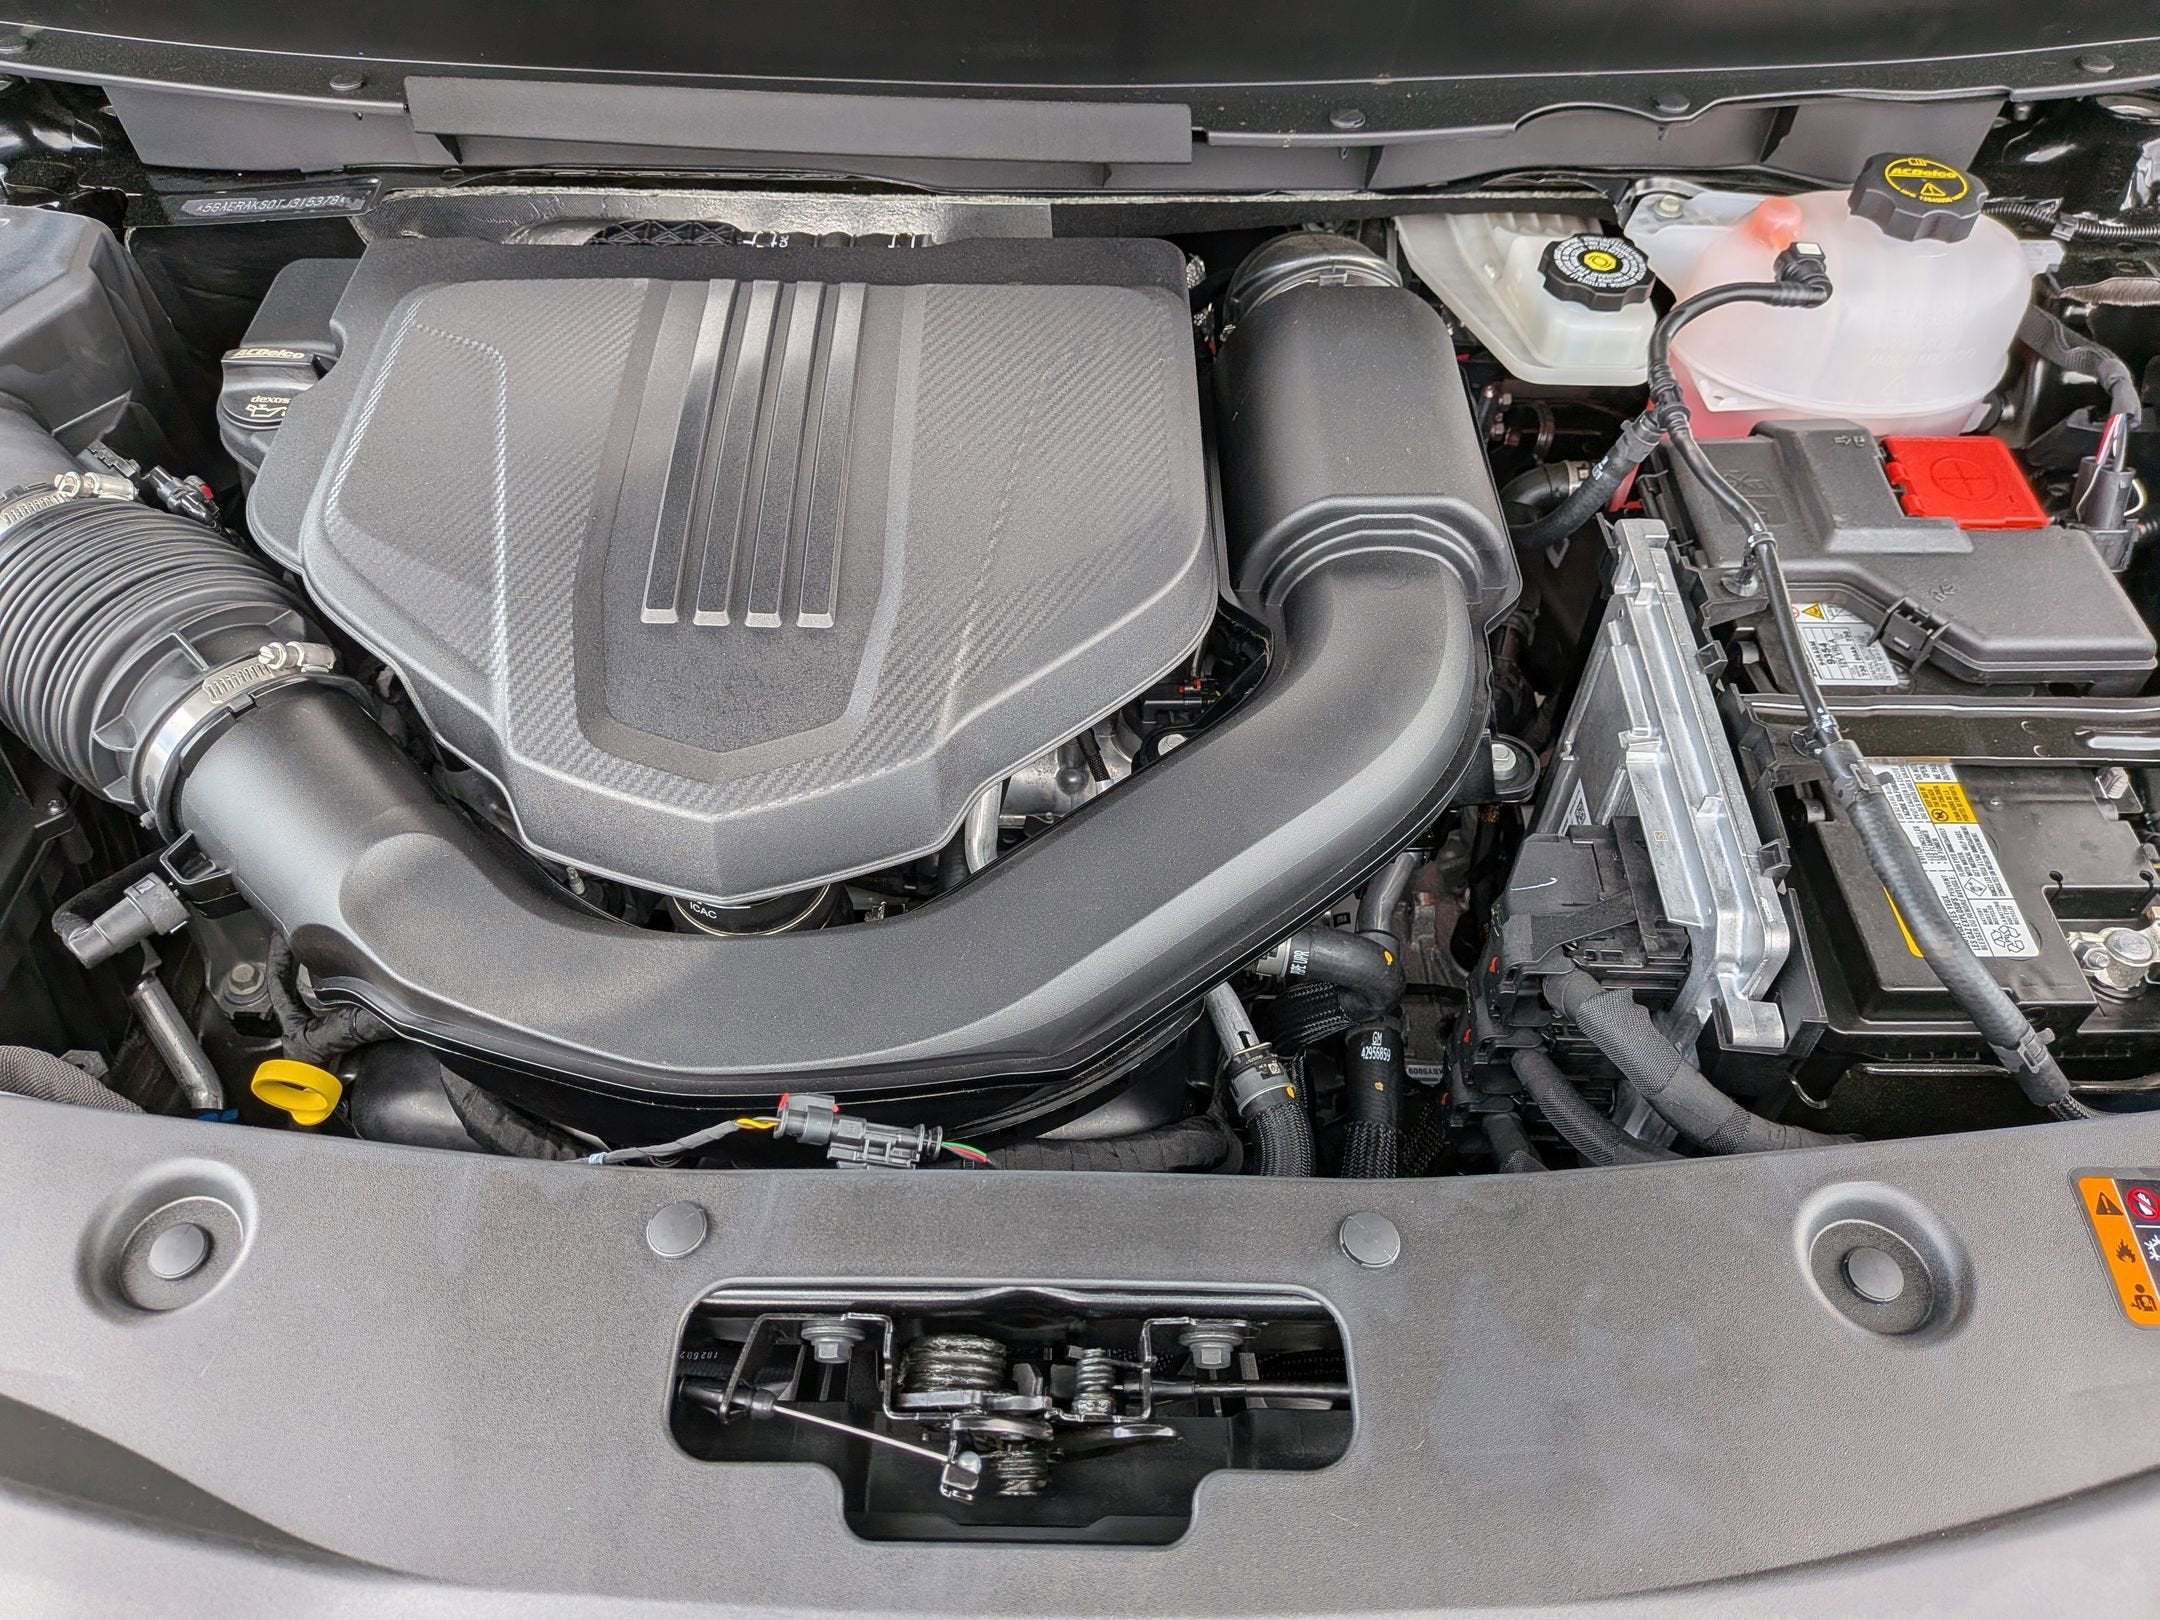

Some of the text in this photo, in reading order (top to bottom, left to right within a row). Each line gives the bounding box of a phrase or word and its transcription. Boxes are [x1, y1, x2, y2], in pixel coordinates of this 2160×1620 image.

[231, 348, 305, 360] ACDelco
[250, 395, 292, 404] dexos
[1818, 642, 1836, 664] 9354
[1372, 1031, 1383, 1045] GM
